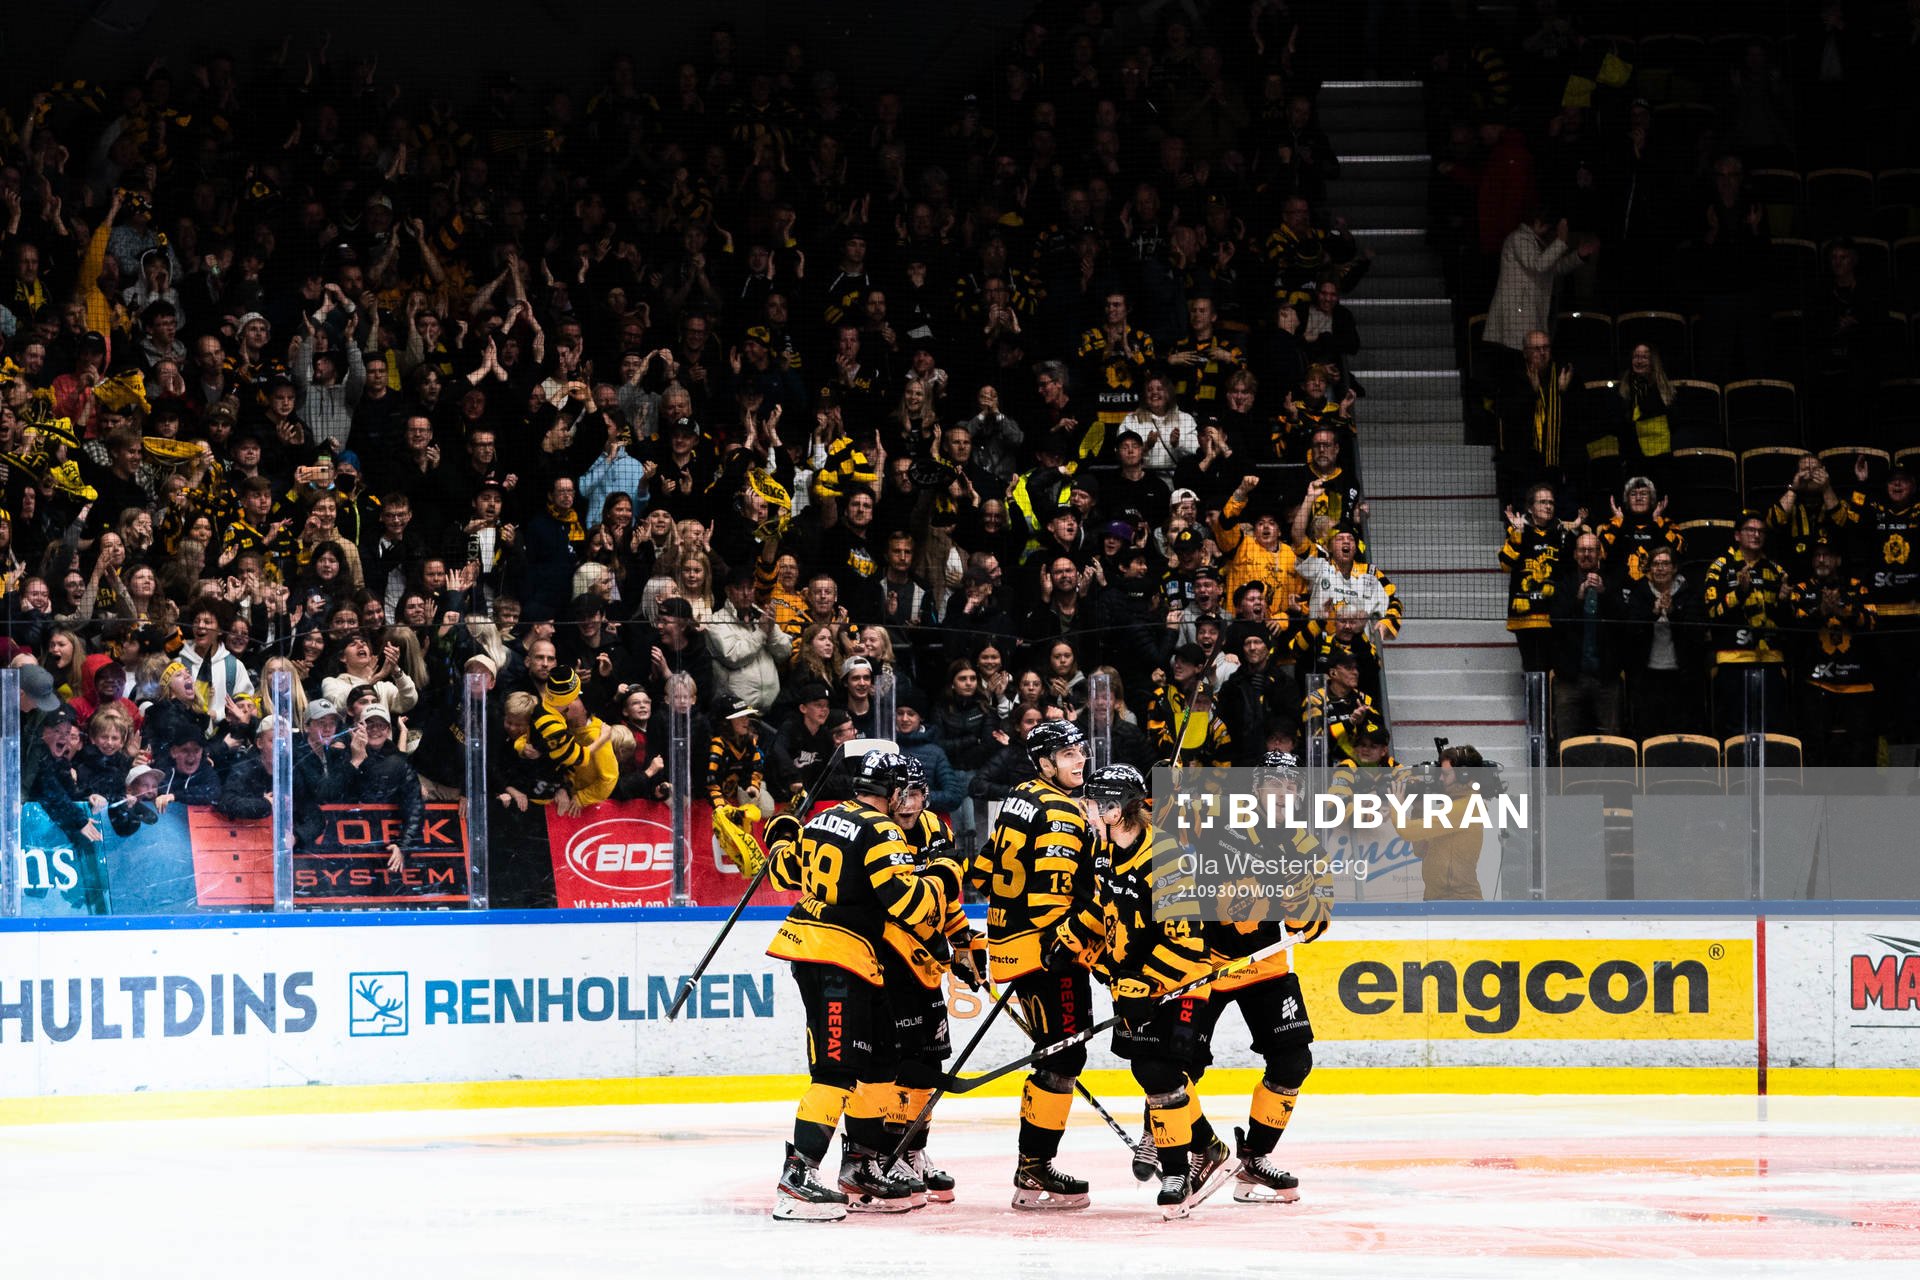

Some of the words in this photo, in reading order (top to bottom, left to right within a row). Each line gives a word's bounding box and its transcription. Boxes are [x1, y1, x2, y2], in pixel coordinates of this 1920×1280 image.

[295, 867, 455, 887] SYSTEM
[1050, 872, 1073, 894] 13
[1164, 916, 1191, 939] 64
[0, 971, 318, 1043] HULTDINS
[424, 972, 774, 1026] RENHOLMEN
[1060, 977, 1077, 1035] REPAY
[1338, 958, 1710, 1034] engcon
[827, 1001, 843, 1062] REPAY
